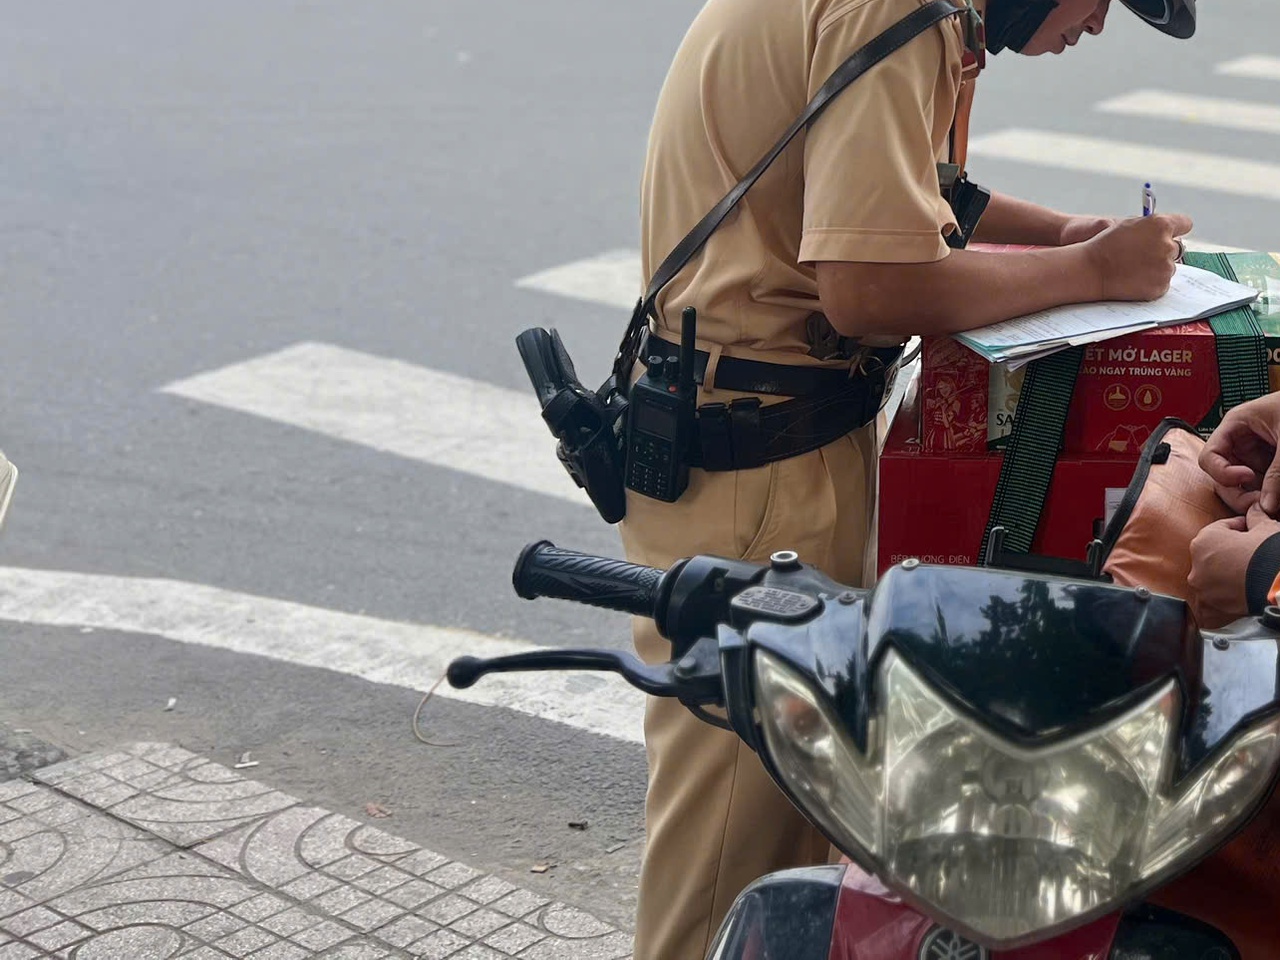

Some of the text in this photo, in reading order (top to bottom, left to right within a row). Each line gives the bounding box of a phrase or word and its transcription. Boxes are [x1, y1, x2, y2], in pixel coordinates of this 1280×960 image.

[1109, 345, 1137, 362] MỞ
[1140, 349, 1193, 363] LAGER
[1099, 367, 1126, 375] NGAY
[1128, 365, 1162, 376] TRÚNG
[1164, 366, 1192, 377] VÀNG
